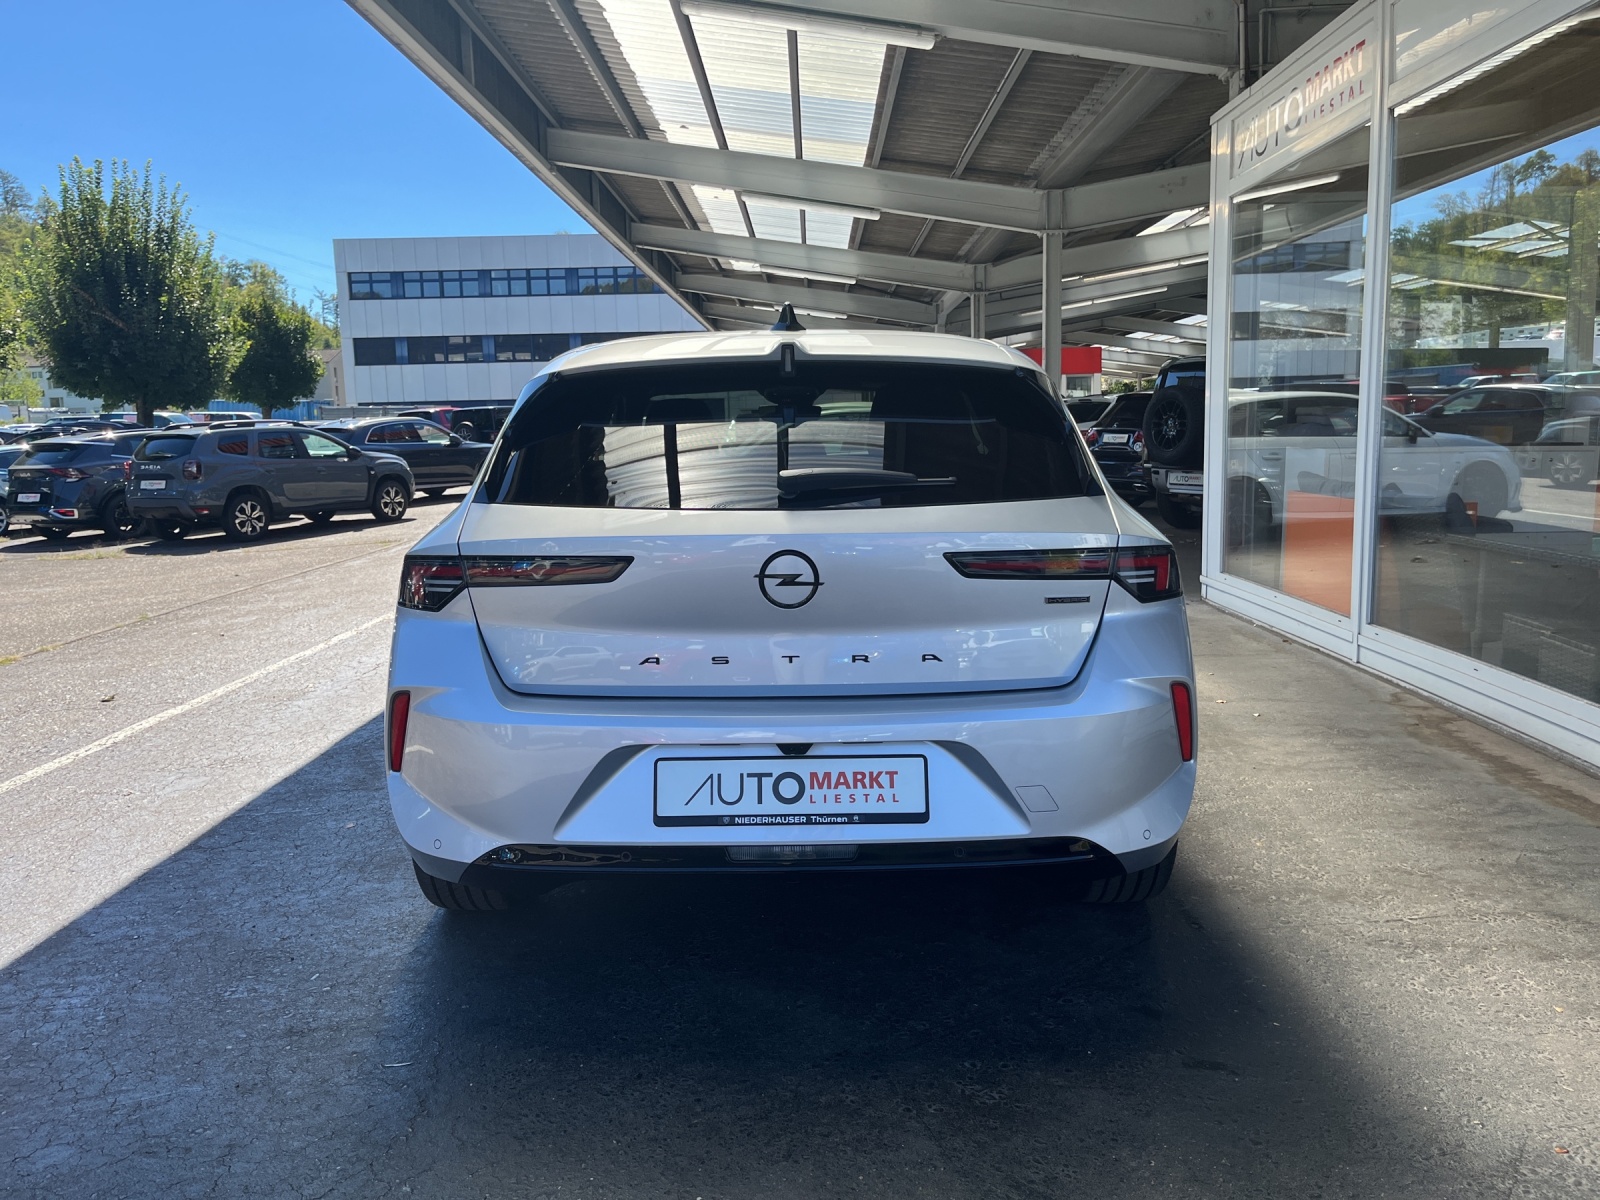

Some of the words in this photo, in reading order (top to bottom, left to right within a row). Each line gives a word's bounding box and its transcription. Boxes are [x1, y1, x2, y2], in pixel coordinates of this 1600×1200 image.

[1238, 87, 1303, 169] AUTO
[1305, 39, 1366, 107] MARKT
[1304, 80, 1364, 124] LIESTAL
[638, 654, 944, 666] ASTRA
[684, 771, 806, 806] AUTO
[809, 770, 899, 790] MARKT
[809, 793, 899, 804] LIESTAL
[734, 816, 807, 824] NIEDERHAUSER
[810, 815, 848, 823] Thürnen
